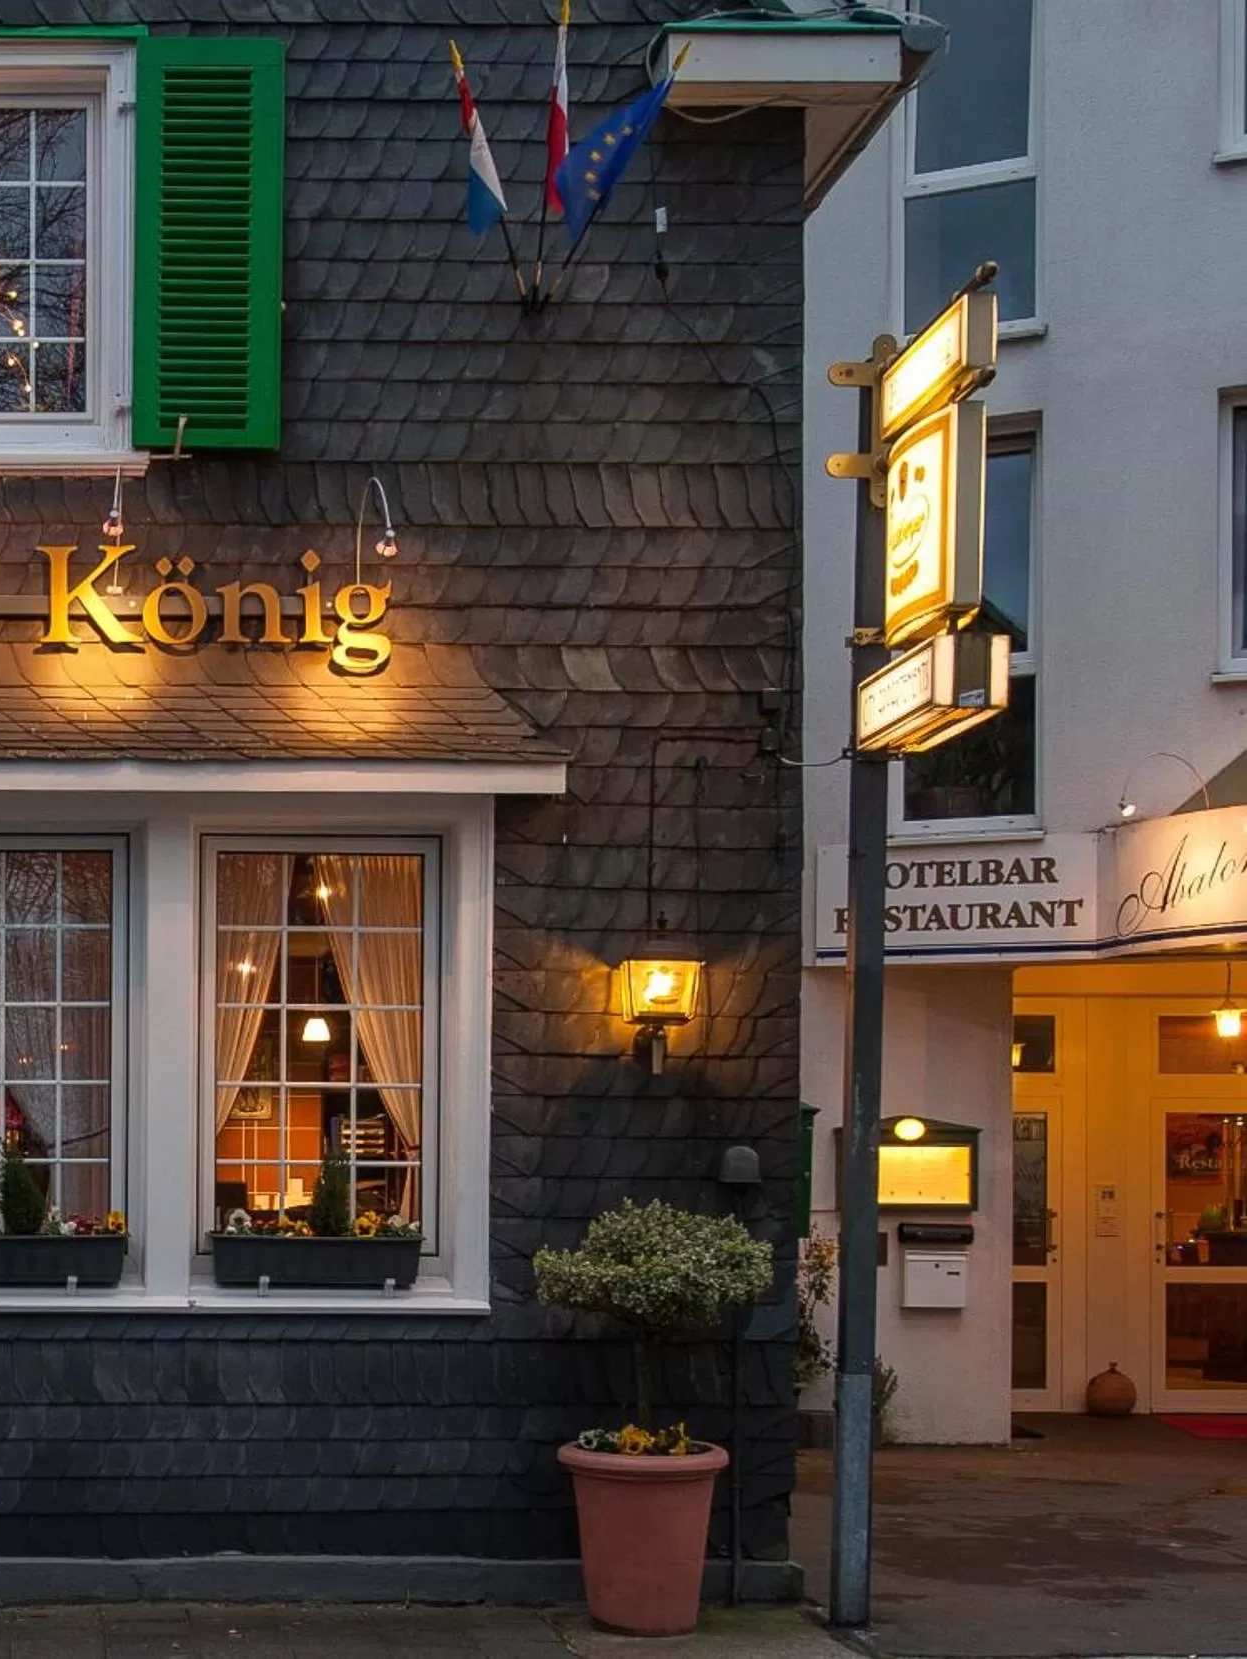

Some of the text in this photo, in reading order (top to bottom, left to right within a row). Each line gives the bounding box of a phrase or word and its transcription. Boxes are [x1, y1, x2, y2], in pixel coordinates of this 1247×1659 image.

[34, 544, 392, 675] König
[884, 857, 1058, 889] OTELBAR
[833, 898, 1083, 933] RSTAURANT
